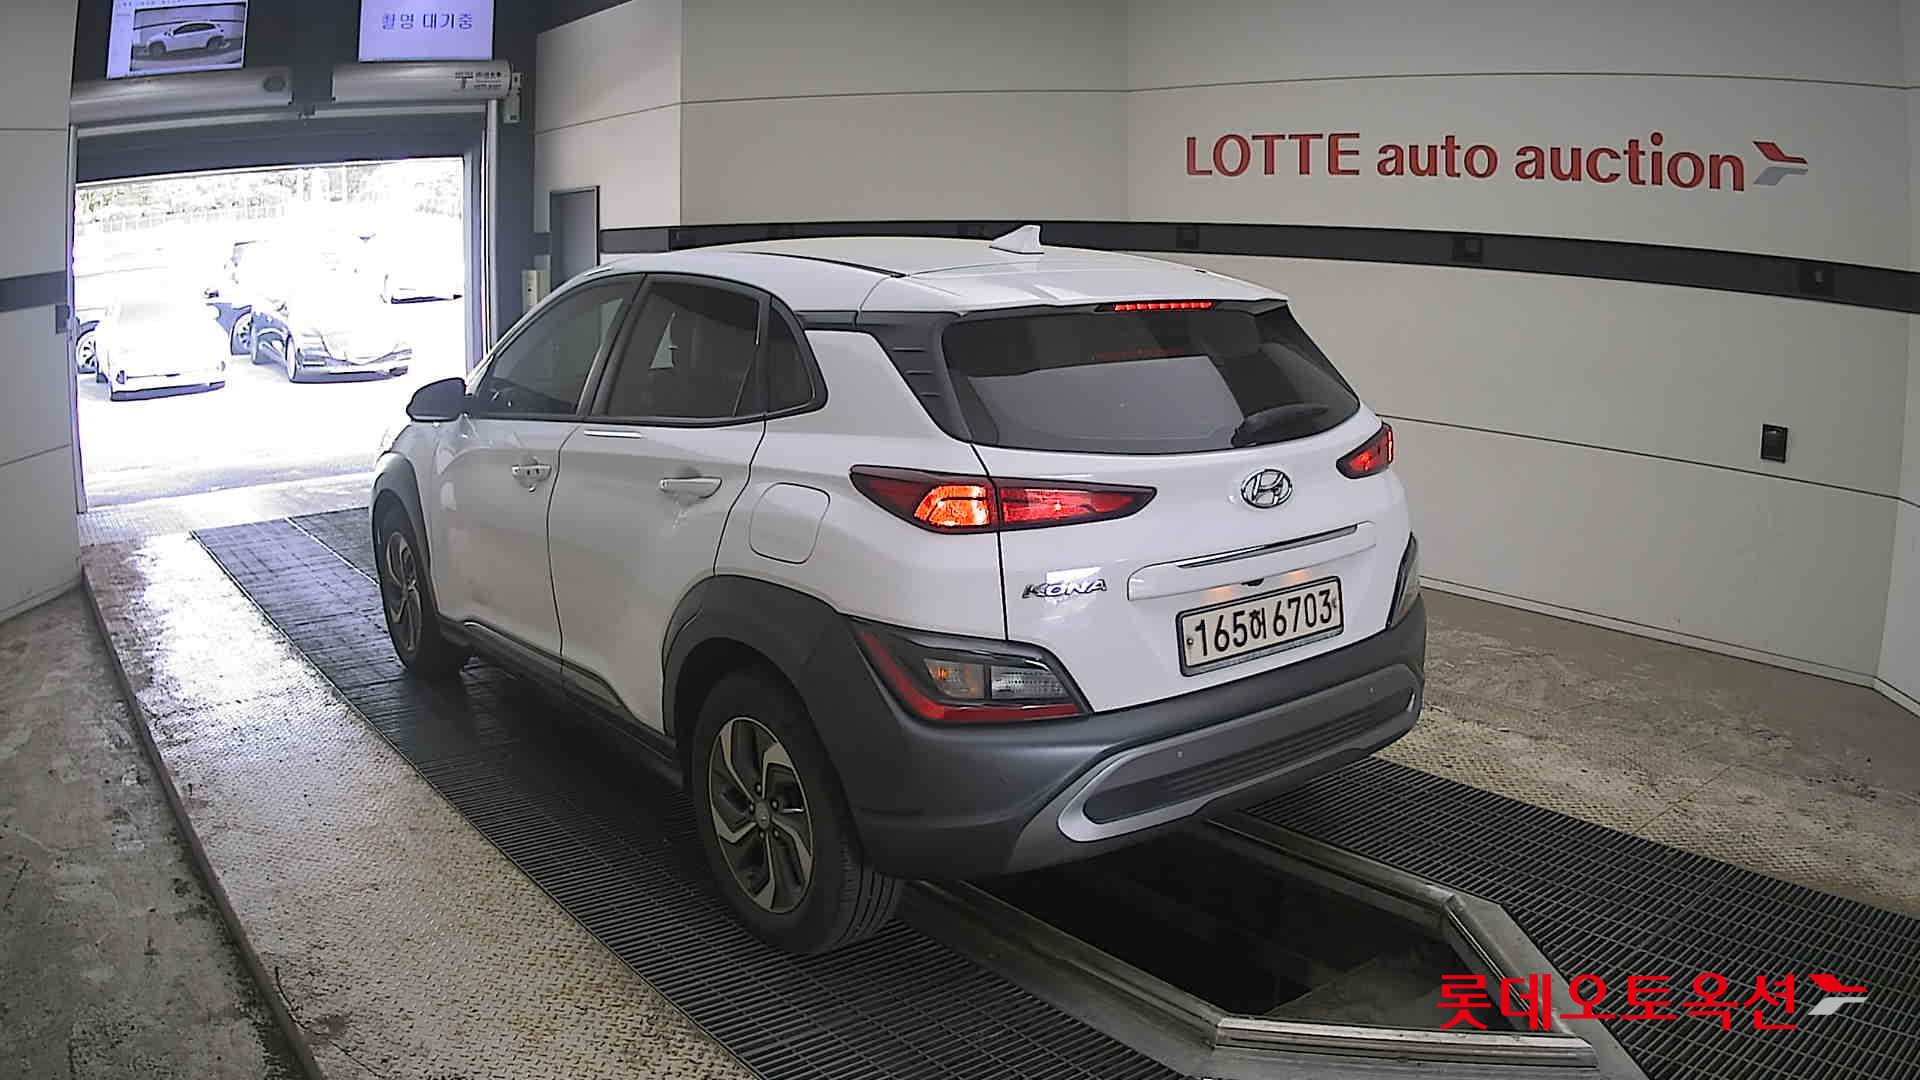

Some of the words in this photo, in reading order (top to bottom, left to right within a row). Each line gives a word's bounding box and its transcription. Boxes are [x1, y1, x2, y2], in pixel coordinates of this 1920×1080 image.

[1186, 133, 1361, 177] LOTTE
[1376, 134, 1499, 179] auto
[1515, 132, 1745, 192] auction
[1022, 578, 1107, 599] KONA
